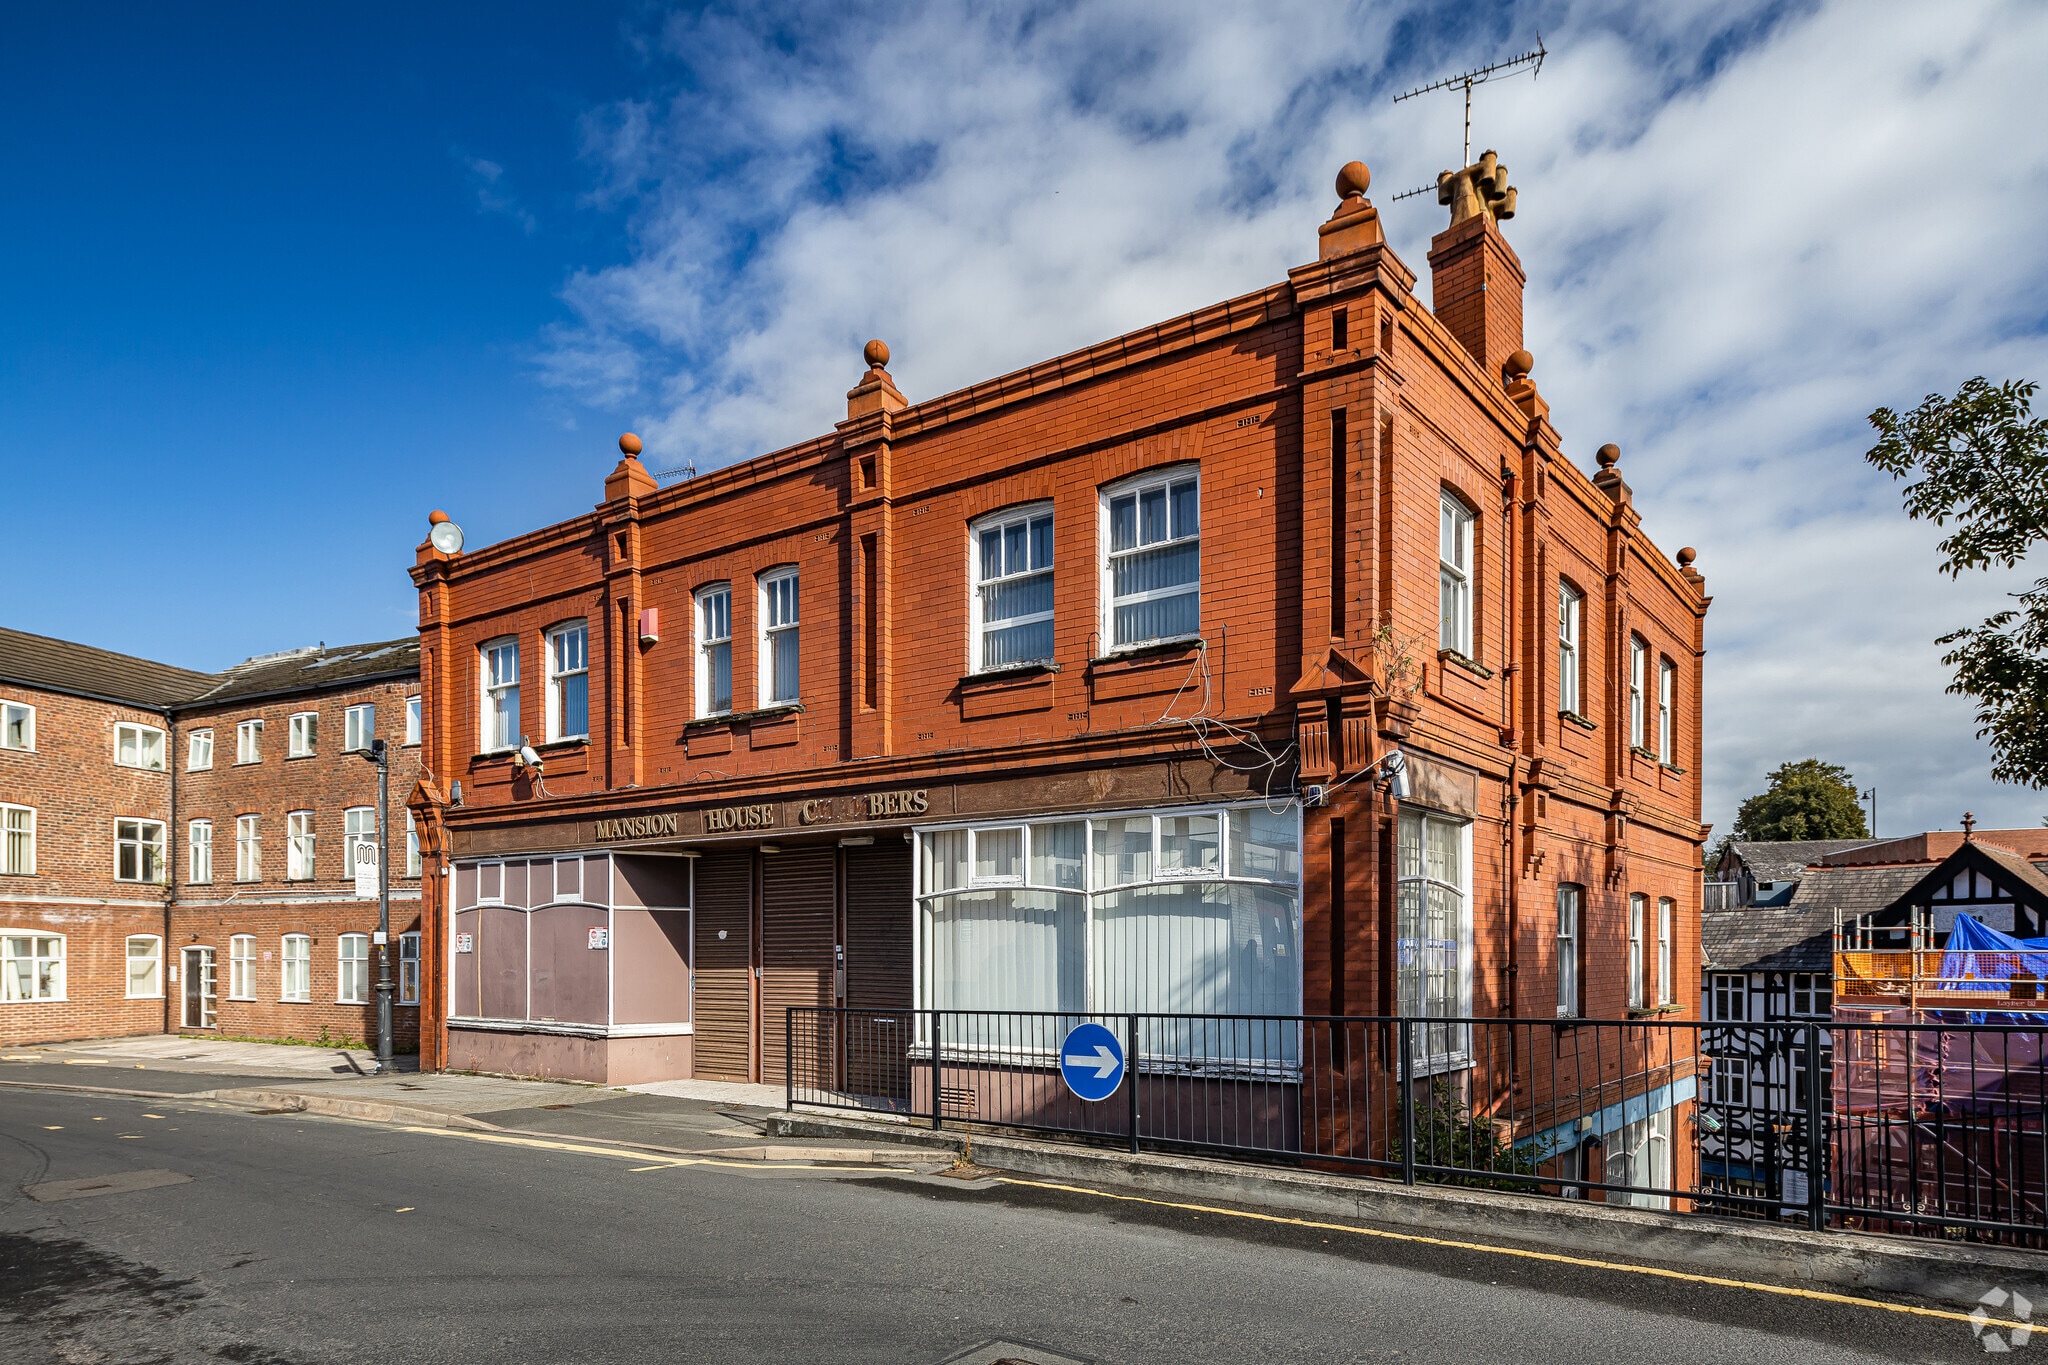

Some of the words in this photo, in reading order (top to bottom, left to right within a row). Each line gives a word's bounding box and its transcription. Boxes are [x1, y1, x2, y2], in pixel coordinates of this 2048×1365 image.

[595, 813, 677, 839] MANSION
[708, 804, 773, 830] HOUSE
[803, 789, 928, 822] CBERS
